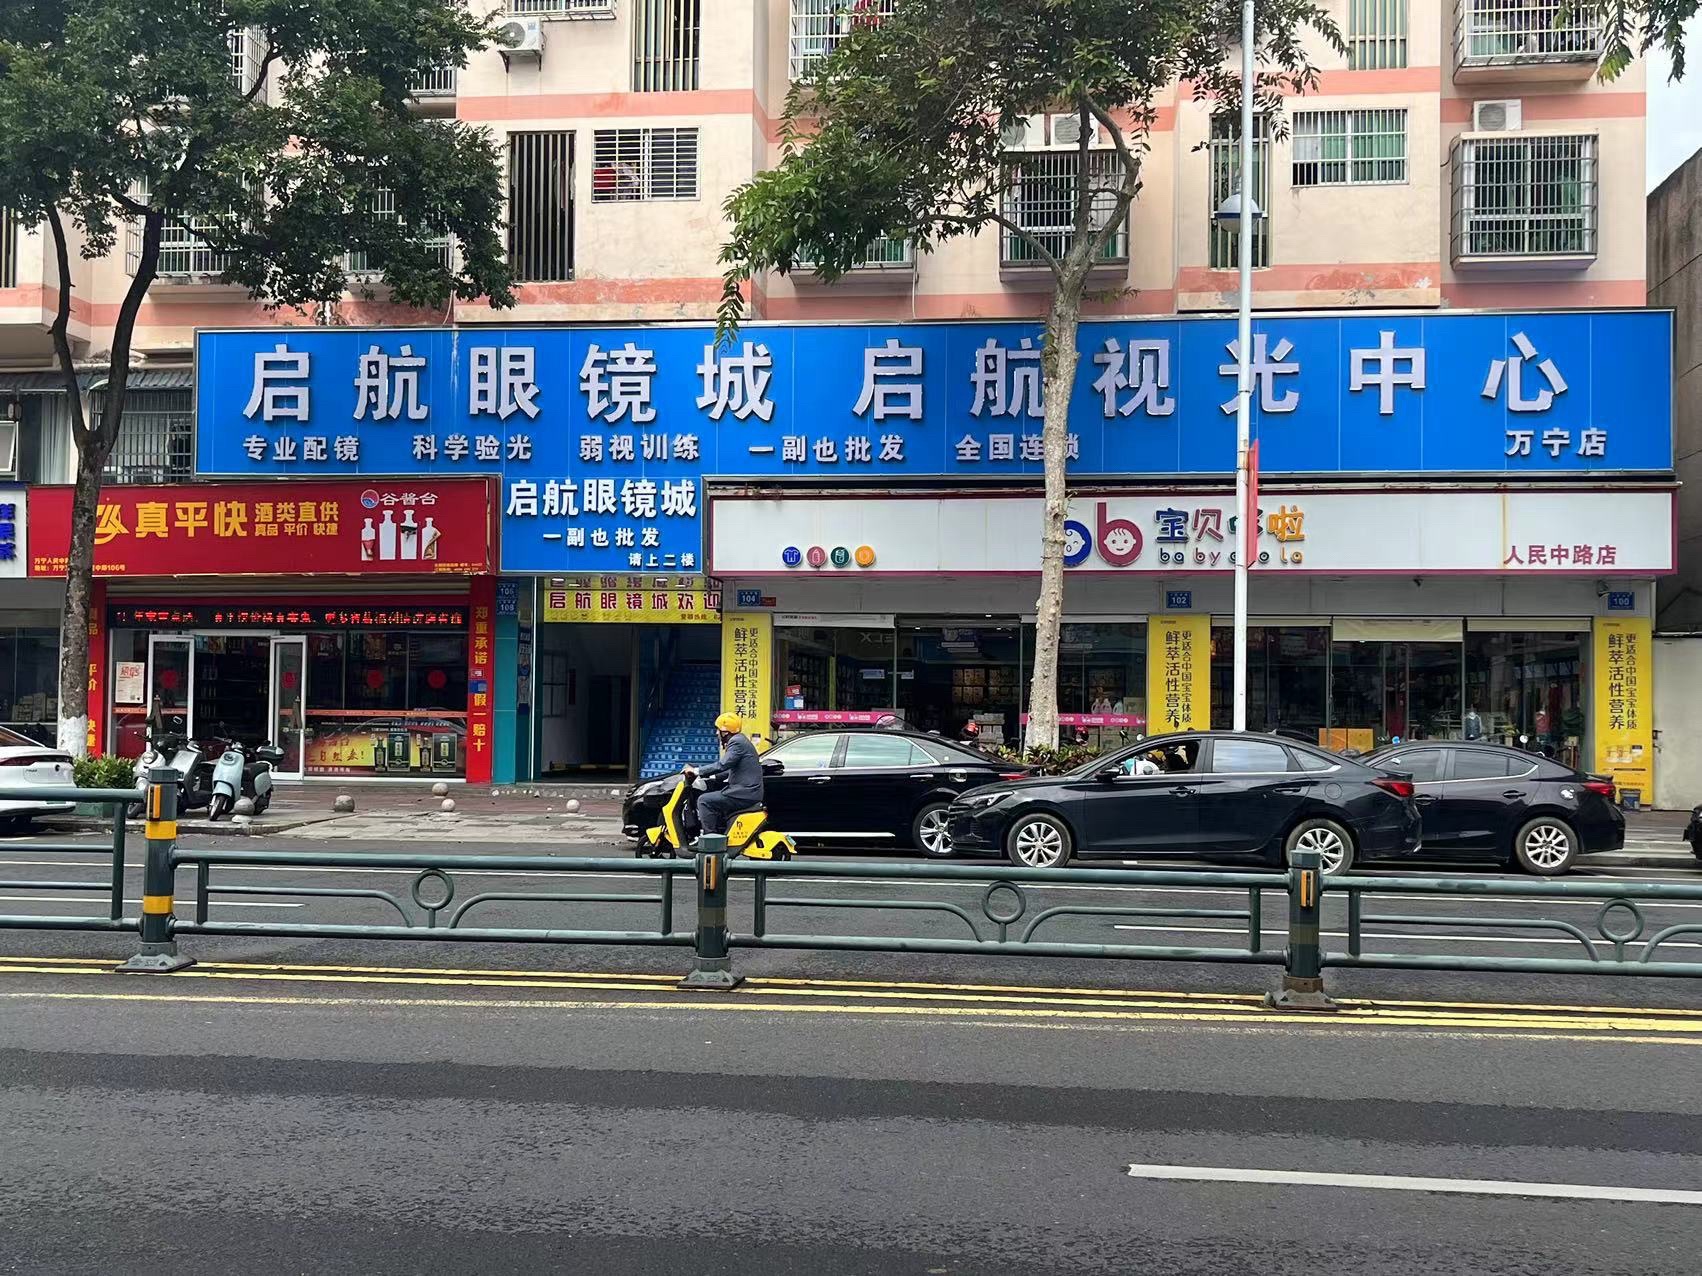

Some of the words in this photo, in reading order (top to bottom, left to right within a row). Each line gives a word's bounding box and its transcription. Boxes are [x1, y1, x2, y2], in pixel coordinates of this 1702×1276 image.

[243, 340, 776, 423] 启航眼镜城
[852, 330, 1567, 421] 启航视光中心
[243, 434, 360, 462] 专业配镜
[413, 434, 532, 461] 科学验光
[580, 434, 699, 461] 弱视训练
[748, 433, 905, 462] 一副也批发
[1505, 429, 1608, 457] 万宁店
[255, 502, 339, 523] 酒类直供
[380, 492, 438, 506] 谷酱台
[507, 478, 697, 518] 启航眼镜城
[135, 501, 248, 537] 真平快
[284, 523, 308, 536] 平价
[313, 523, 338, 536] 快捷
[543, 527, 660, 547] 一副也批发
[628, 552, 695, 567] 请上二楼
[1504, 544, 1616, 566] 人民中路店
[549, 591, 721, 610] 启航眼镜城欢迎
[742, 594, 756, 603] 104
[1172, 596, 1187, 604] 102
[1613, 597, 1630, 606] 100
[474, 606, 488, 664] 郑重承诺
[734, 627, 748, 718] 鲜萃活性营养
[748, 628, 758, 719] 更适合中国宝宝体质
[1165, 630, 1180, 723] 鲜萃活性营养
[1181, 630, 1192, 722] 更适合中国宝宝体质
[1608, 633, 1624, 730] 鲜萃活性营养
[1625, 633, 1637, 730] 更适合中国宝宝体质
[472, 693, 487, 752] 假一赔十
